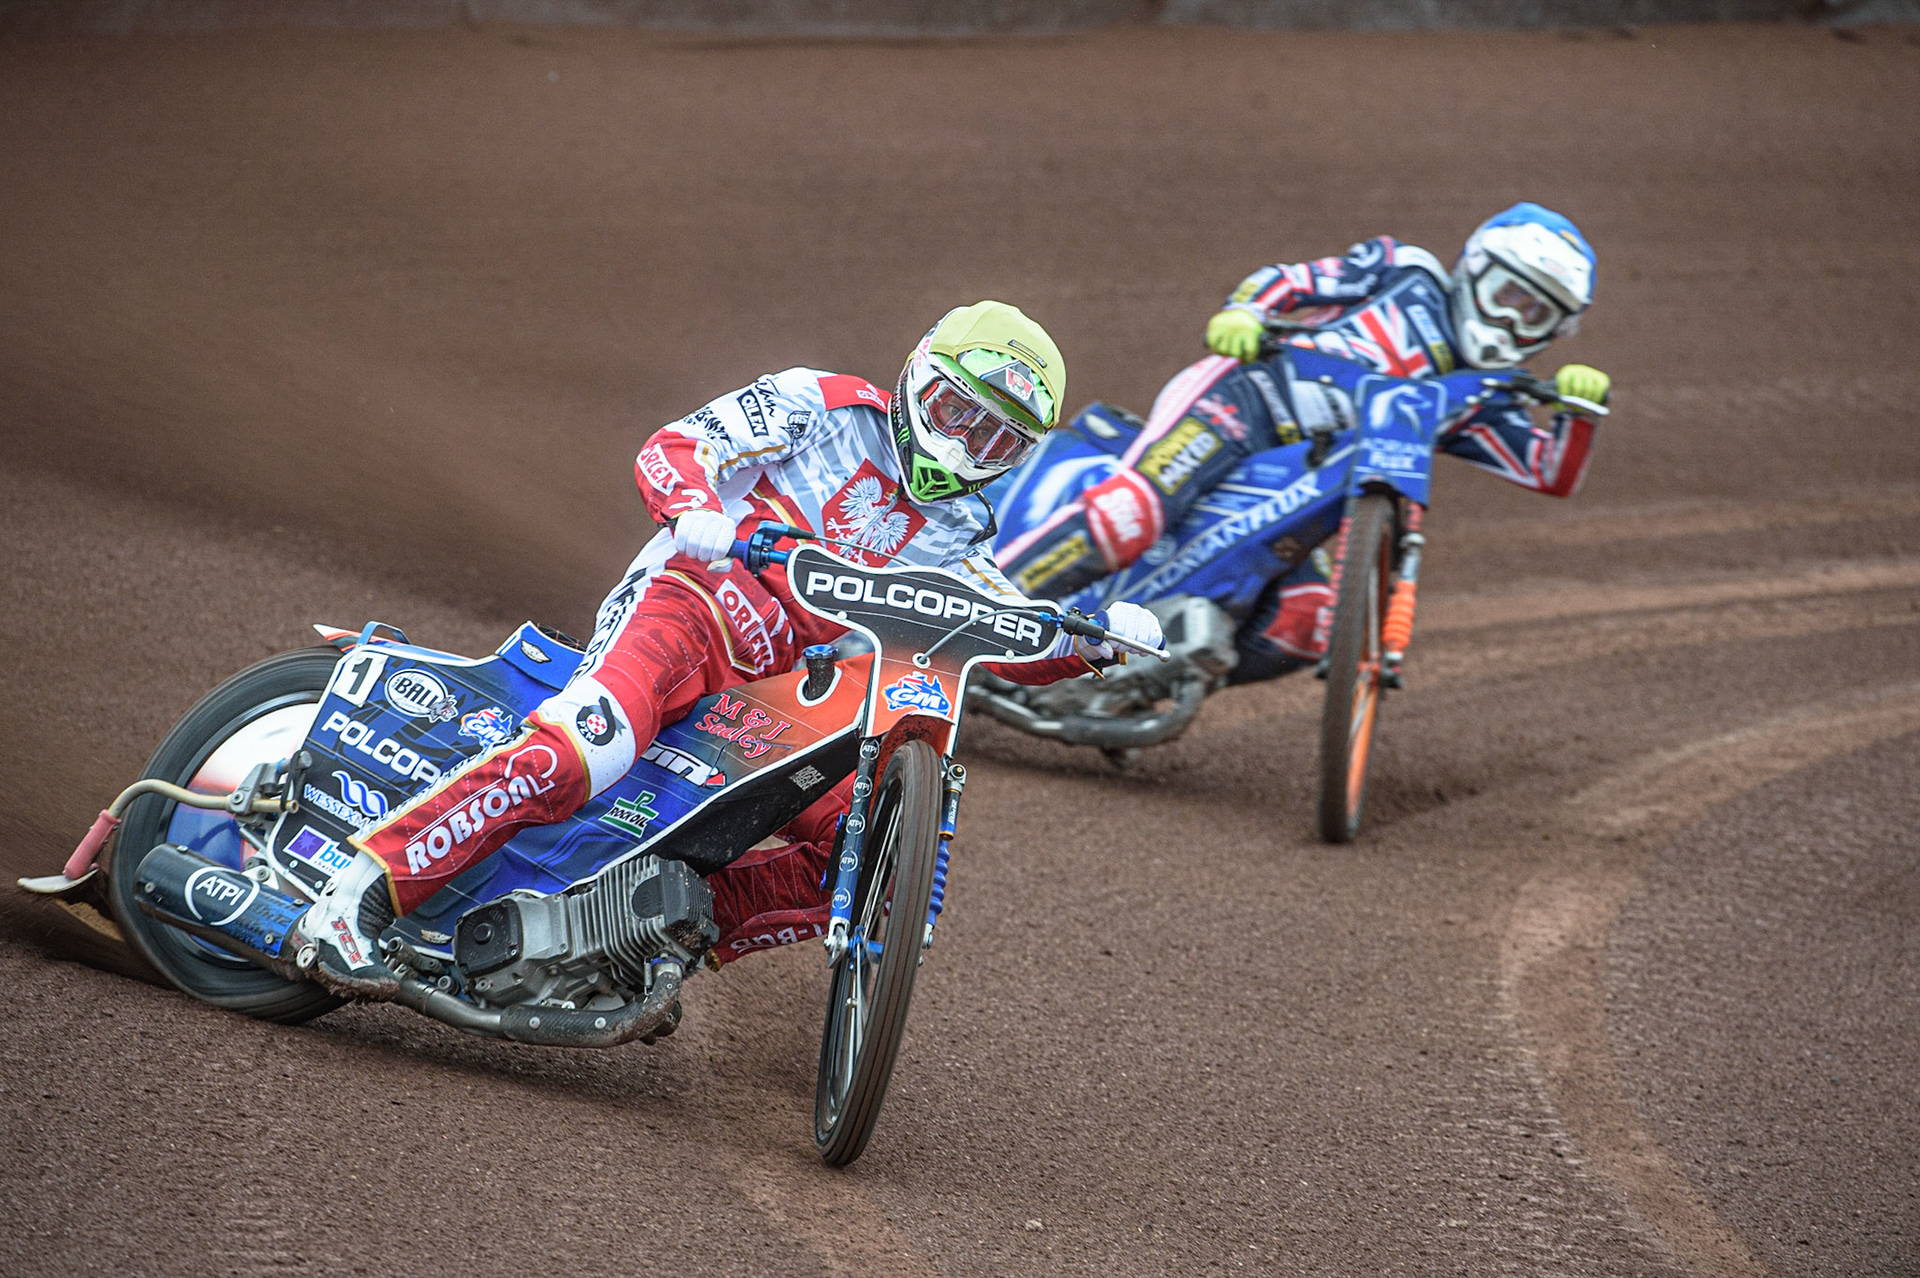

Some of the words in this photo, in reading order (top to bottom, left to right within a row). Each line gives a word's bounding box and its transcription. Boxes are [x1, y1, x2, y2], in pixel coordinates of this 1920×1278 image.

[805, 571, 1042, 647] POLCOPPER
[347, 657, 373, 696] 1
[890, 688, 942, 708] GM
[710, 693, 747, 721] M
[742, 708, 773, 729] &
[760, 720, 792, 741] J
[577, 720, 596, 743] PZM
[861, 744, 878, 754] ATPI
[855, 781, 870, 790] ATPI
[405, 776, 532, 875] ROBSON
[609, 806, 633, 822] ROCK
[631, 814, 649, 828] OIL
[848, 819, 863, 828] ATPI
[195, 876, 247, 906] ATPI
